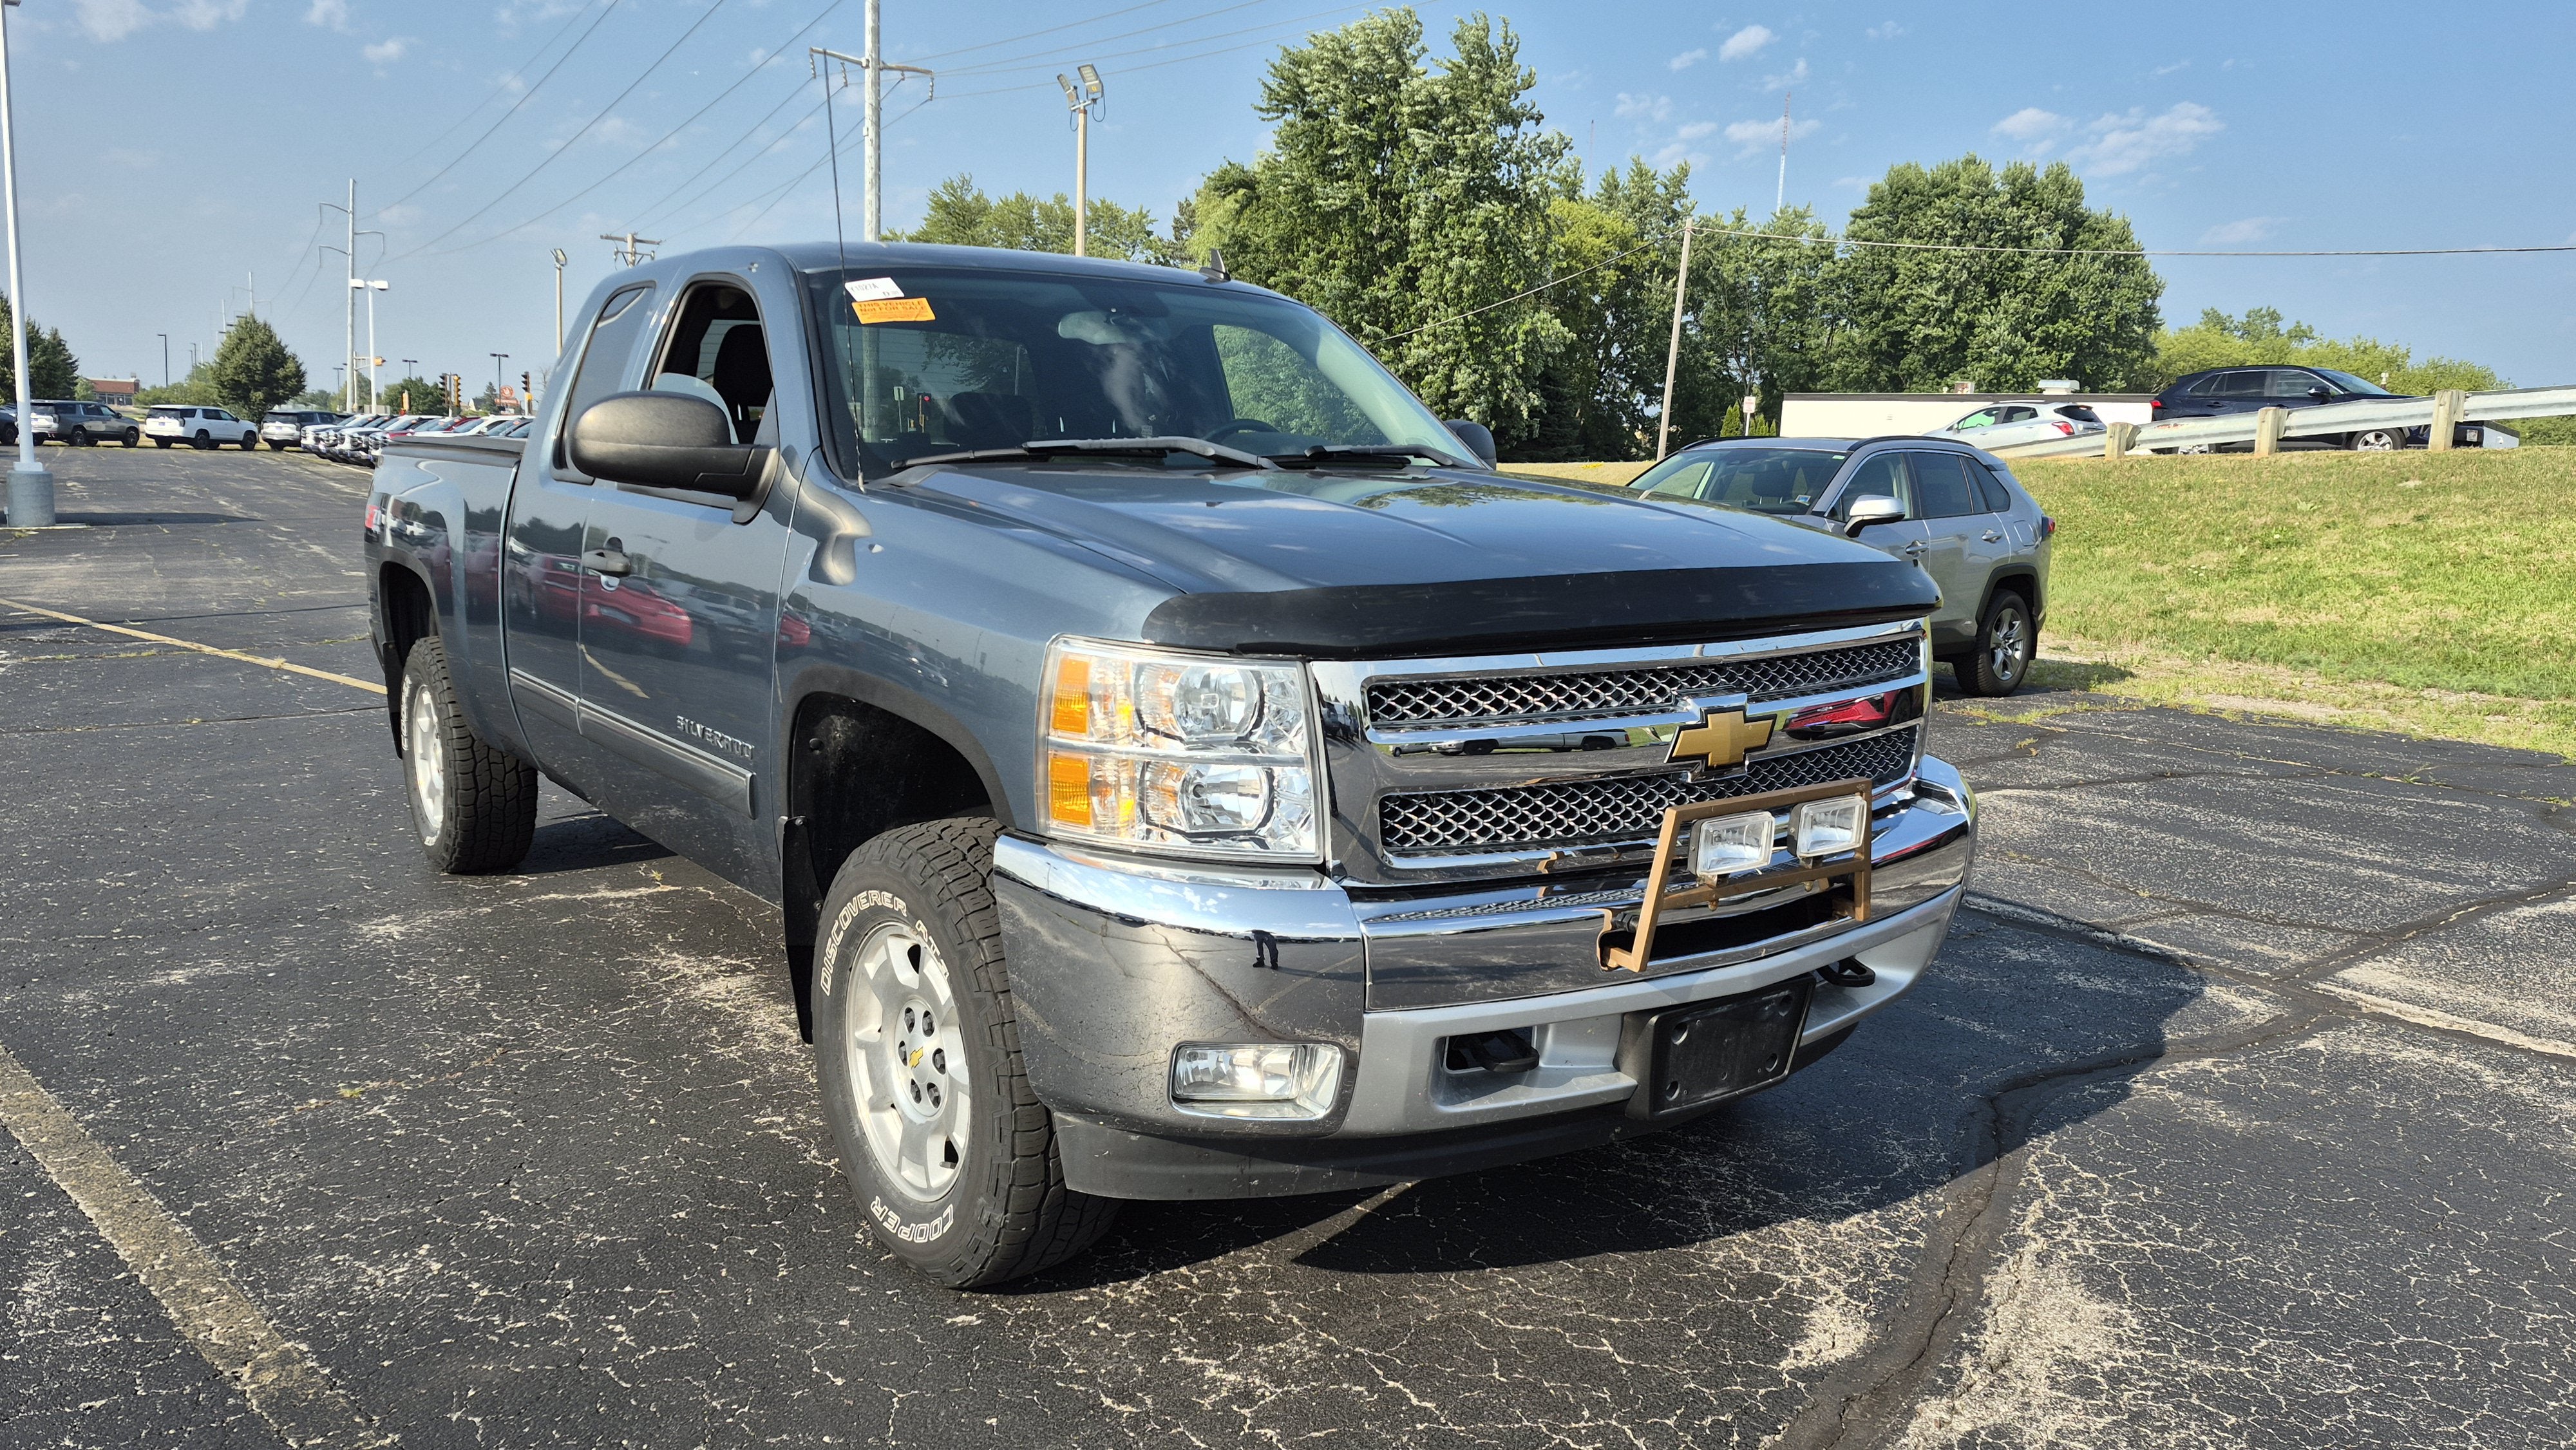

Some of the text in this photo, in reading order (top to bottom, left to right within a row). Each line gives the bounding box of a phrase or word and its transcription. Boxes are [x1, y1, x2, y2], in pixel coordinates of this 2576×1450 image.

[676, 715, 755, 759] SILVERADO
[820, 890, 907, 997] DISCOVERER
[870, 1196, 954, 1243] COOPER
